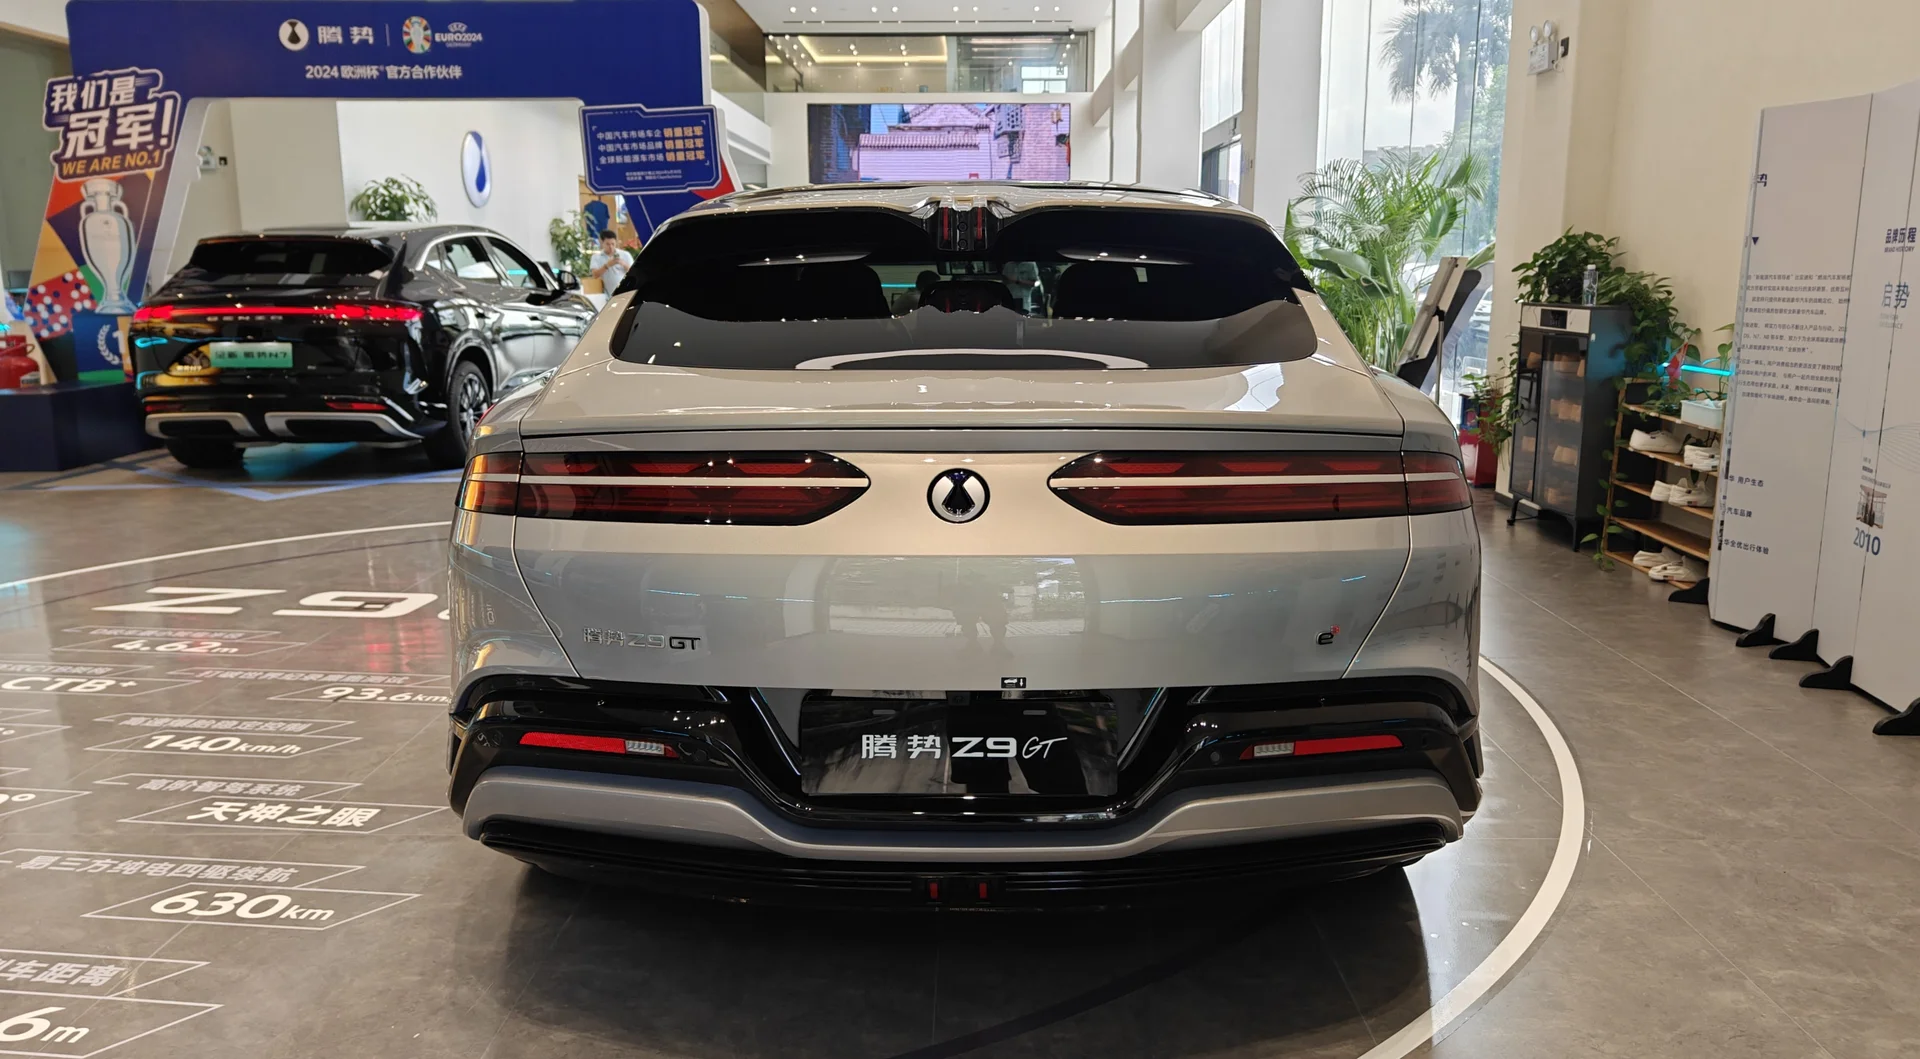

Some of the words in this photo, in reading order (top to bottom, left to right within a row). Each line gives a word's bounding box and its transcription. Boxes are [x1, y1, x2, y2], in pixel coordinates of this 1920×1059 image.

[305, 66, 339, 79] 2024
[385, 65, 462, 79] 官方合作伙伴
[50, 75, 136, 113] 我们是
[60, 99, 174, 159] 冠军!
[62, 160, 87, 176] WE
[89, 155, 121, 172] ARE
[124, 149, 161, 167] NO.1
[1737, 476, 1764, 487] 用户生态
[1853, 527, 1881, 556] 2010
[91, 586, 450, 620] Z9
[112, 640, 240, 653] 4.62m
[582, 627, 625, 647] 腾势
[143, 734, 302, 755] 140km/h
[861, 734, 941, 759] 腾势
[136, 778, 306, 798] 高阶智驾系统
[186, 800, 382, 828] 天神之眼
[15, 855, 300, 883] 易三方纯电四驱续航
[149, 890, 336, 922] 630km
